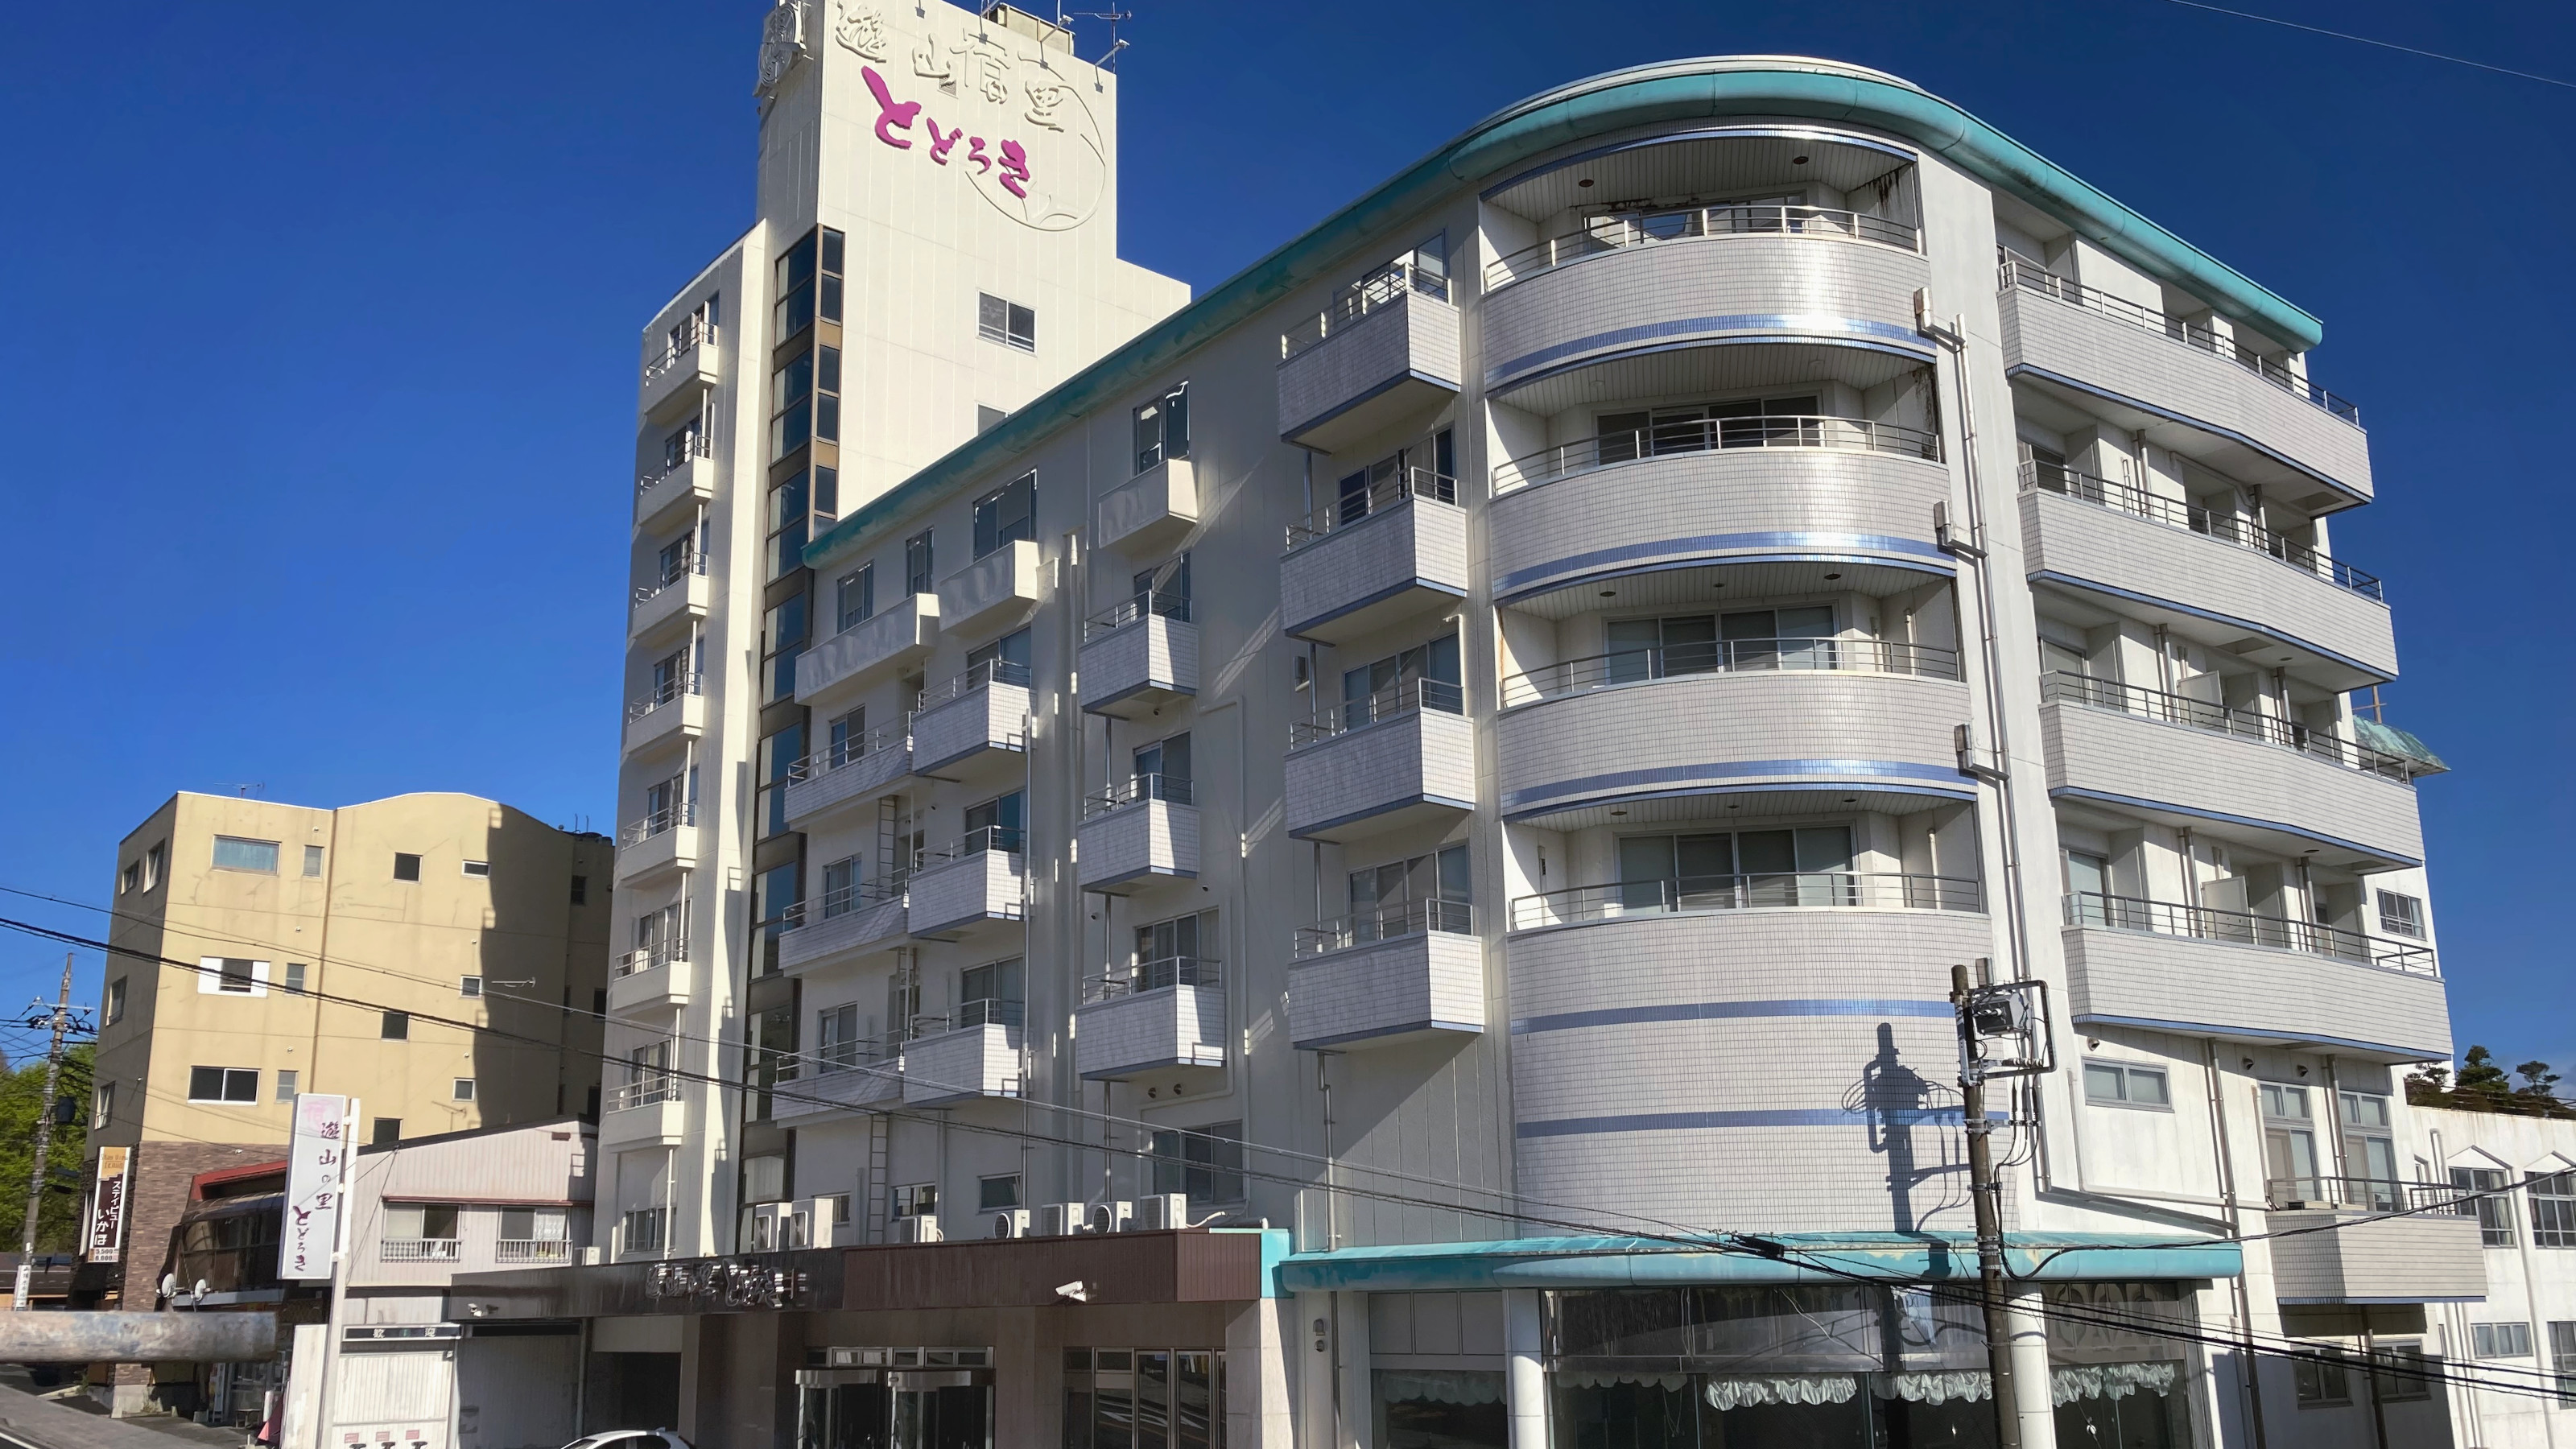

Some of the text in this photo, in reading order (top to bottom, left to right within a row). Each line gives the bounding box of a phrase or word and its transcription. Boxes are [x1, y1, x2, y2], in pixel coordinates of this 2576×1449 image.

[861, 65, 1031, 199] とどろき
[94, 1209, 109, 1245] いかほ
[293, 1205, 312, 1272] とどろき
